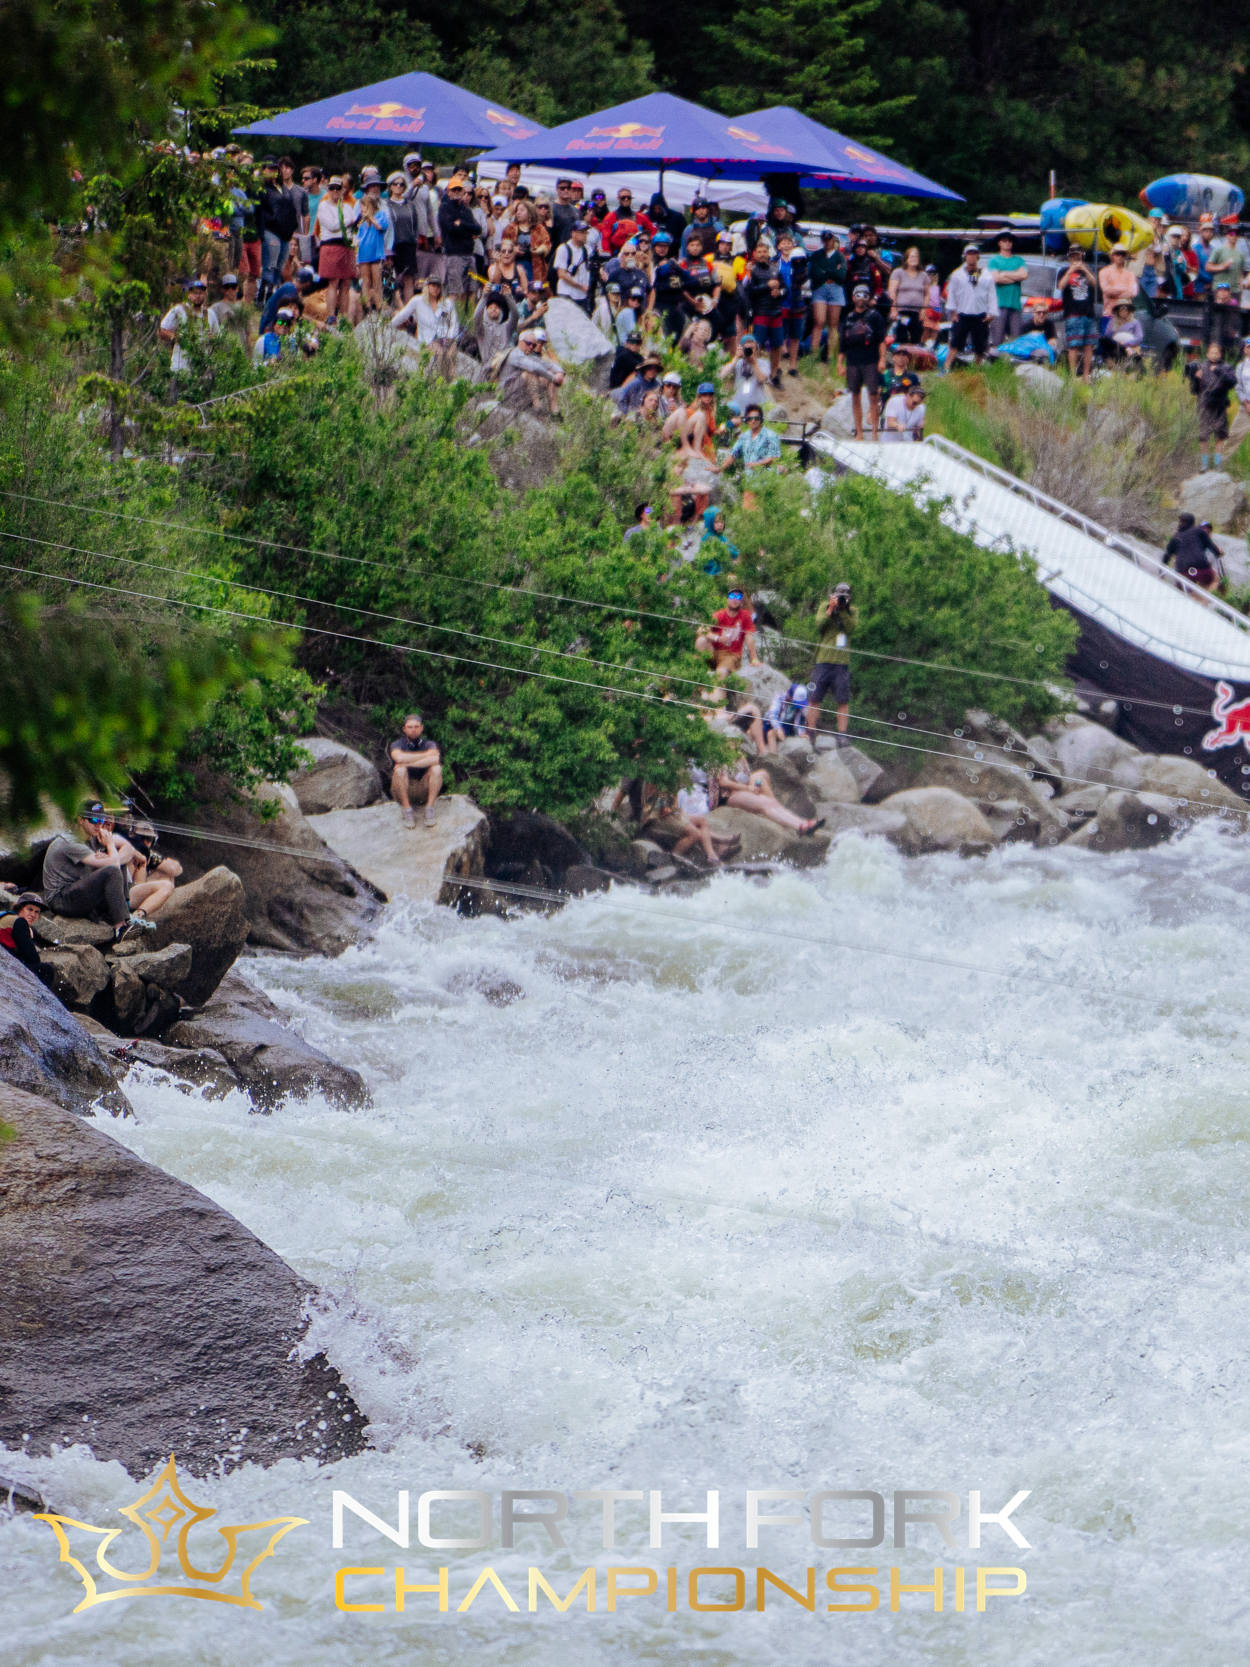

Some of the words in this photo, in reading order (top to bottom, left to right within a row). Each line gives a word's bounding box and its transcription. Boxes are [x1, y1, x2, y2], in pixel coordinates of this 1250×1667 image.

[326, 117, 376, 130] Red
[374, 119, 425, 133] Bull
[566, 138, 615, 150] Red
[614, 138, 664, 150] Bull
